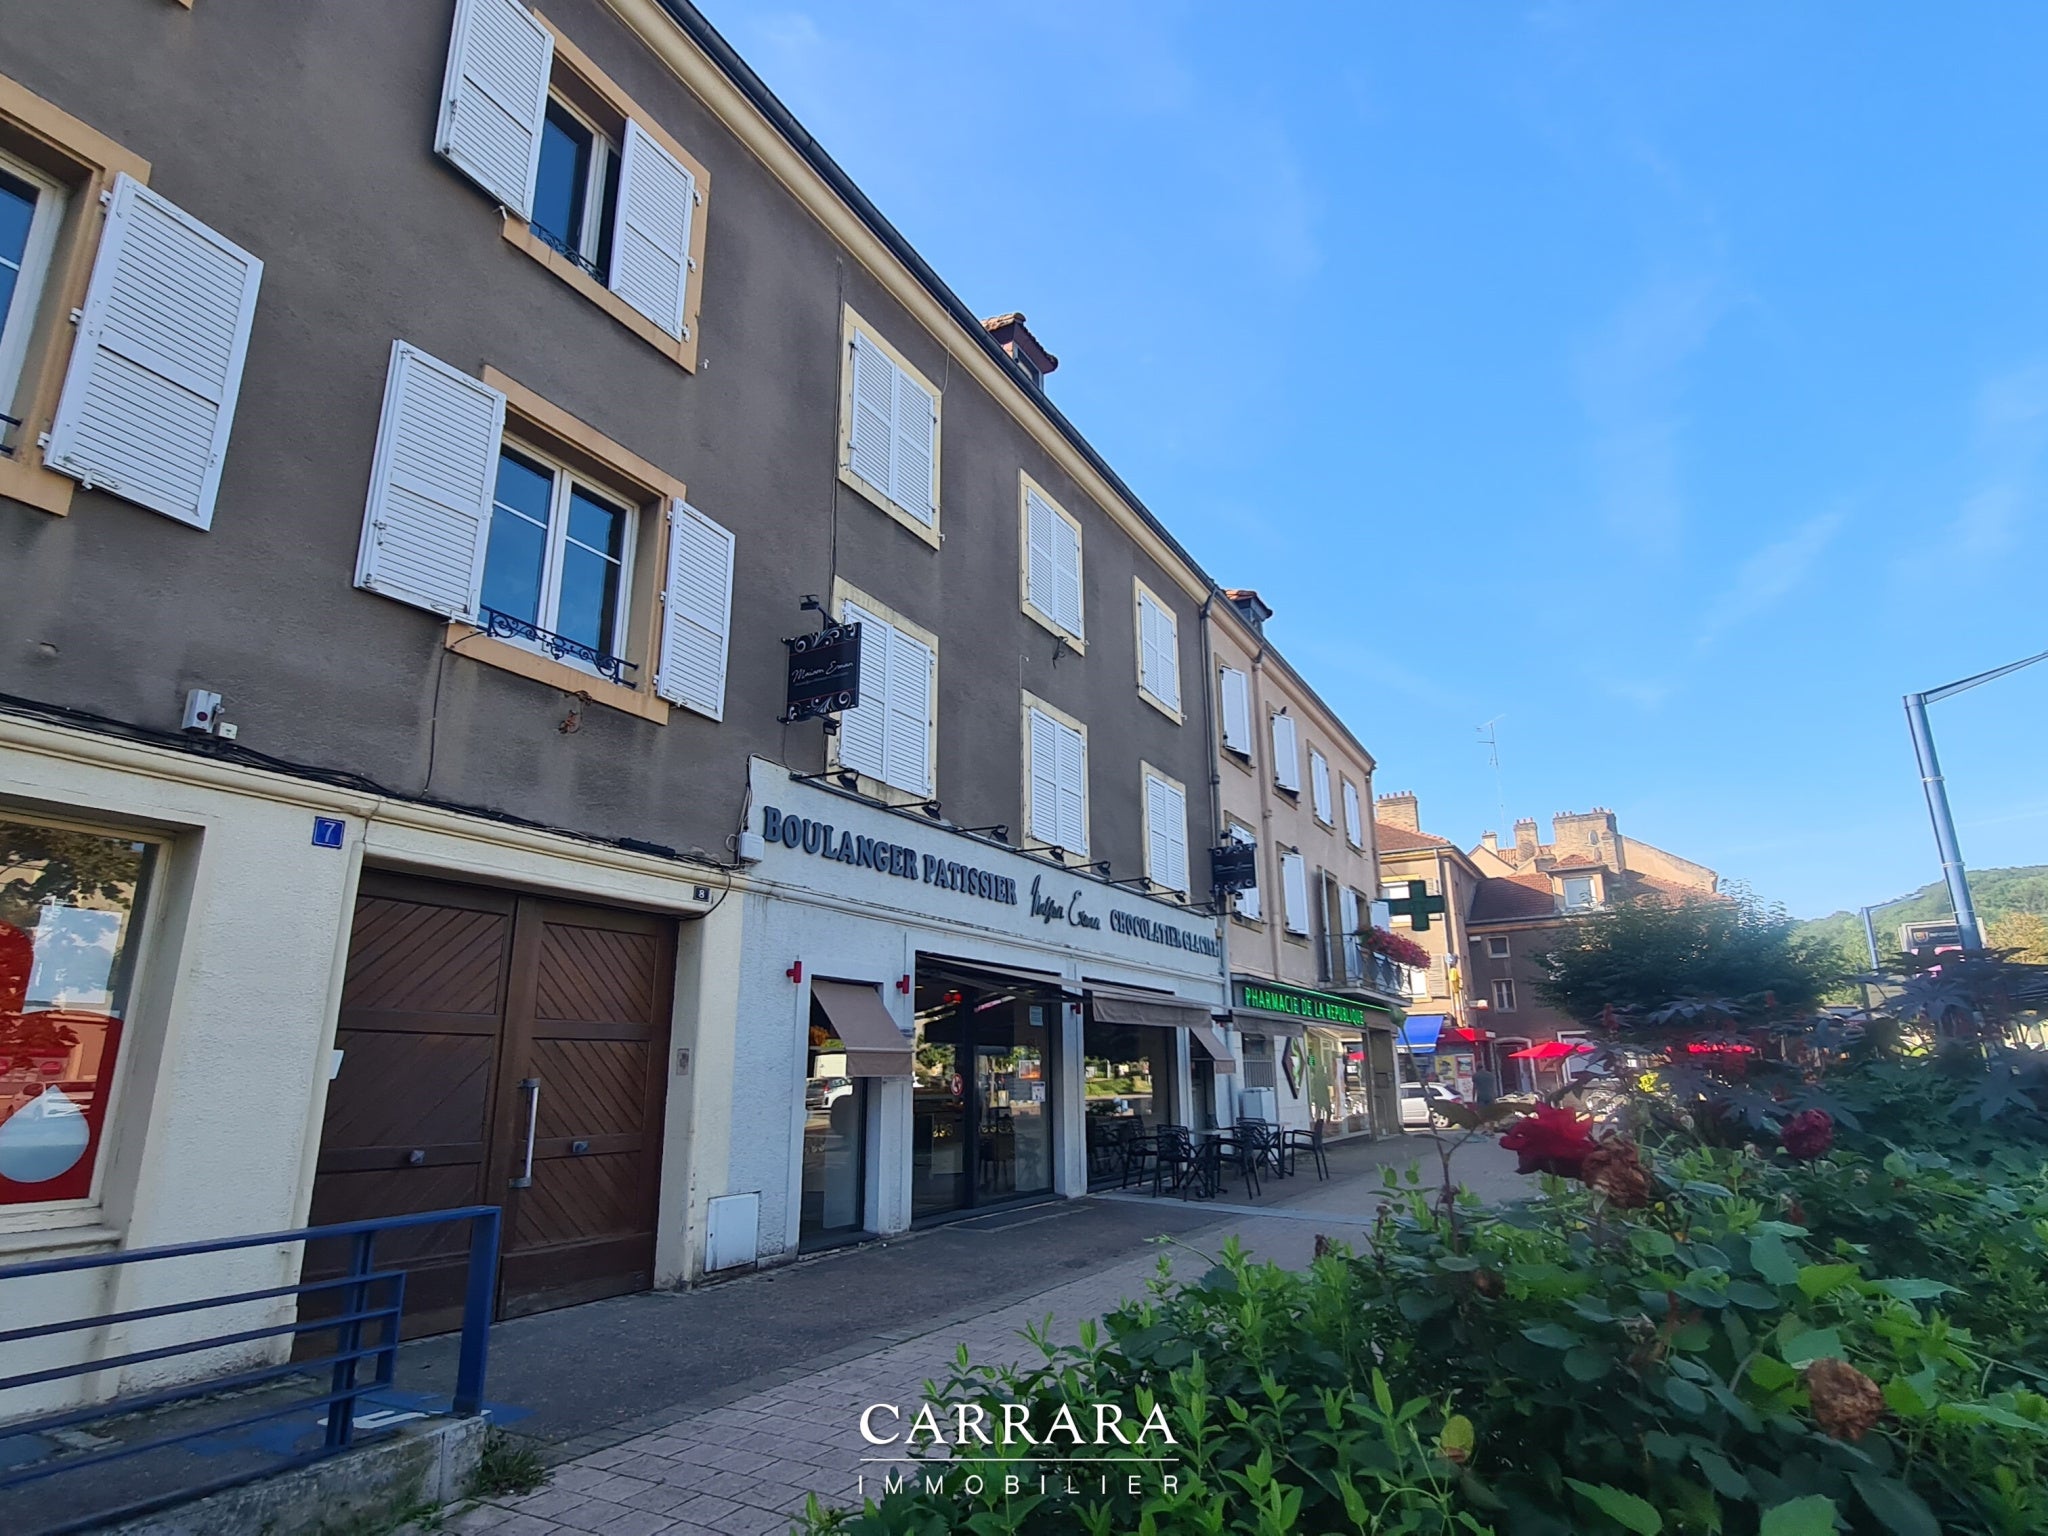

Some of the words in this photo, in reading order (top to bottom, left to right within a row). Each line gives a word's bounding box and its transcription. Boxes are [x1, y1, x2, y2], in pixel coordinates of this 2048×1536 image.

[323, 821, 337, 843] 7
[763, 805, 919, 880] BOULANGER
[923, 854, 1018, 905] PATISSIER
[1109, 909, 1182, 948] CHOCOLATIER
[698, 889, 705, 899] 8
[1244, 987, 1299, 1015] PHARMACIE
[1301, 998, 1312, 1017] DE
[1314, 1002, 1325, 1018] LA
